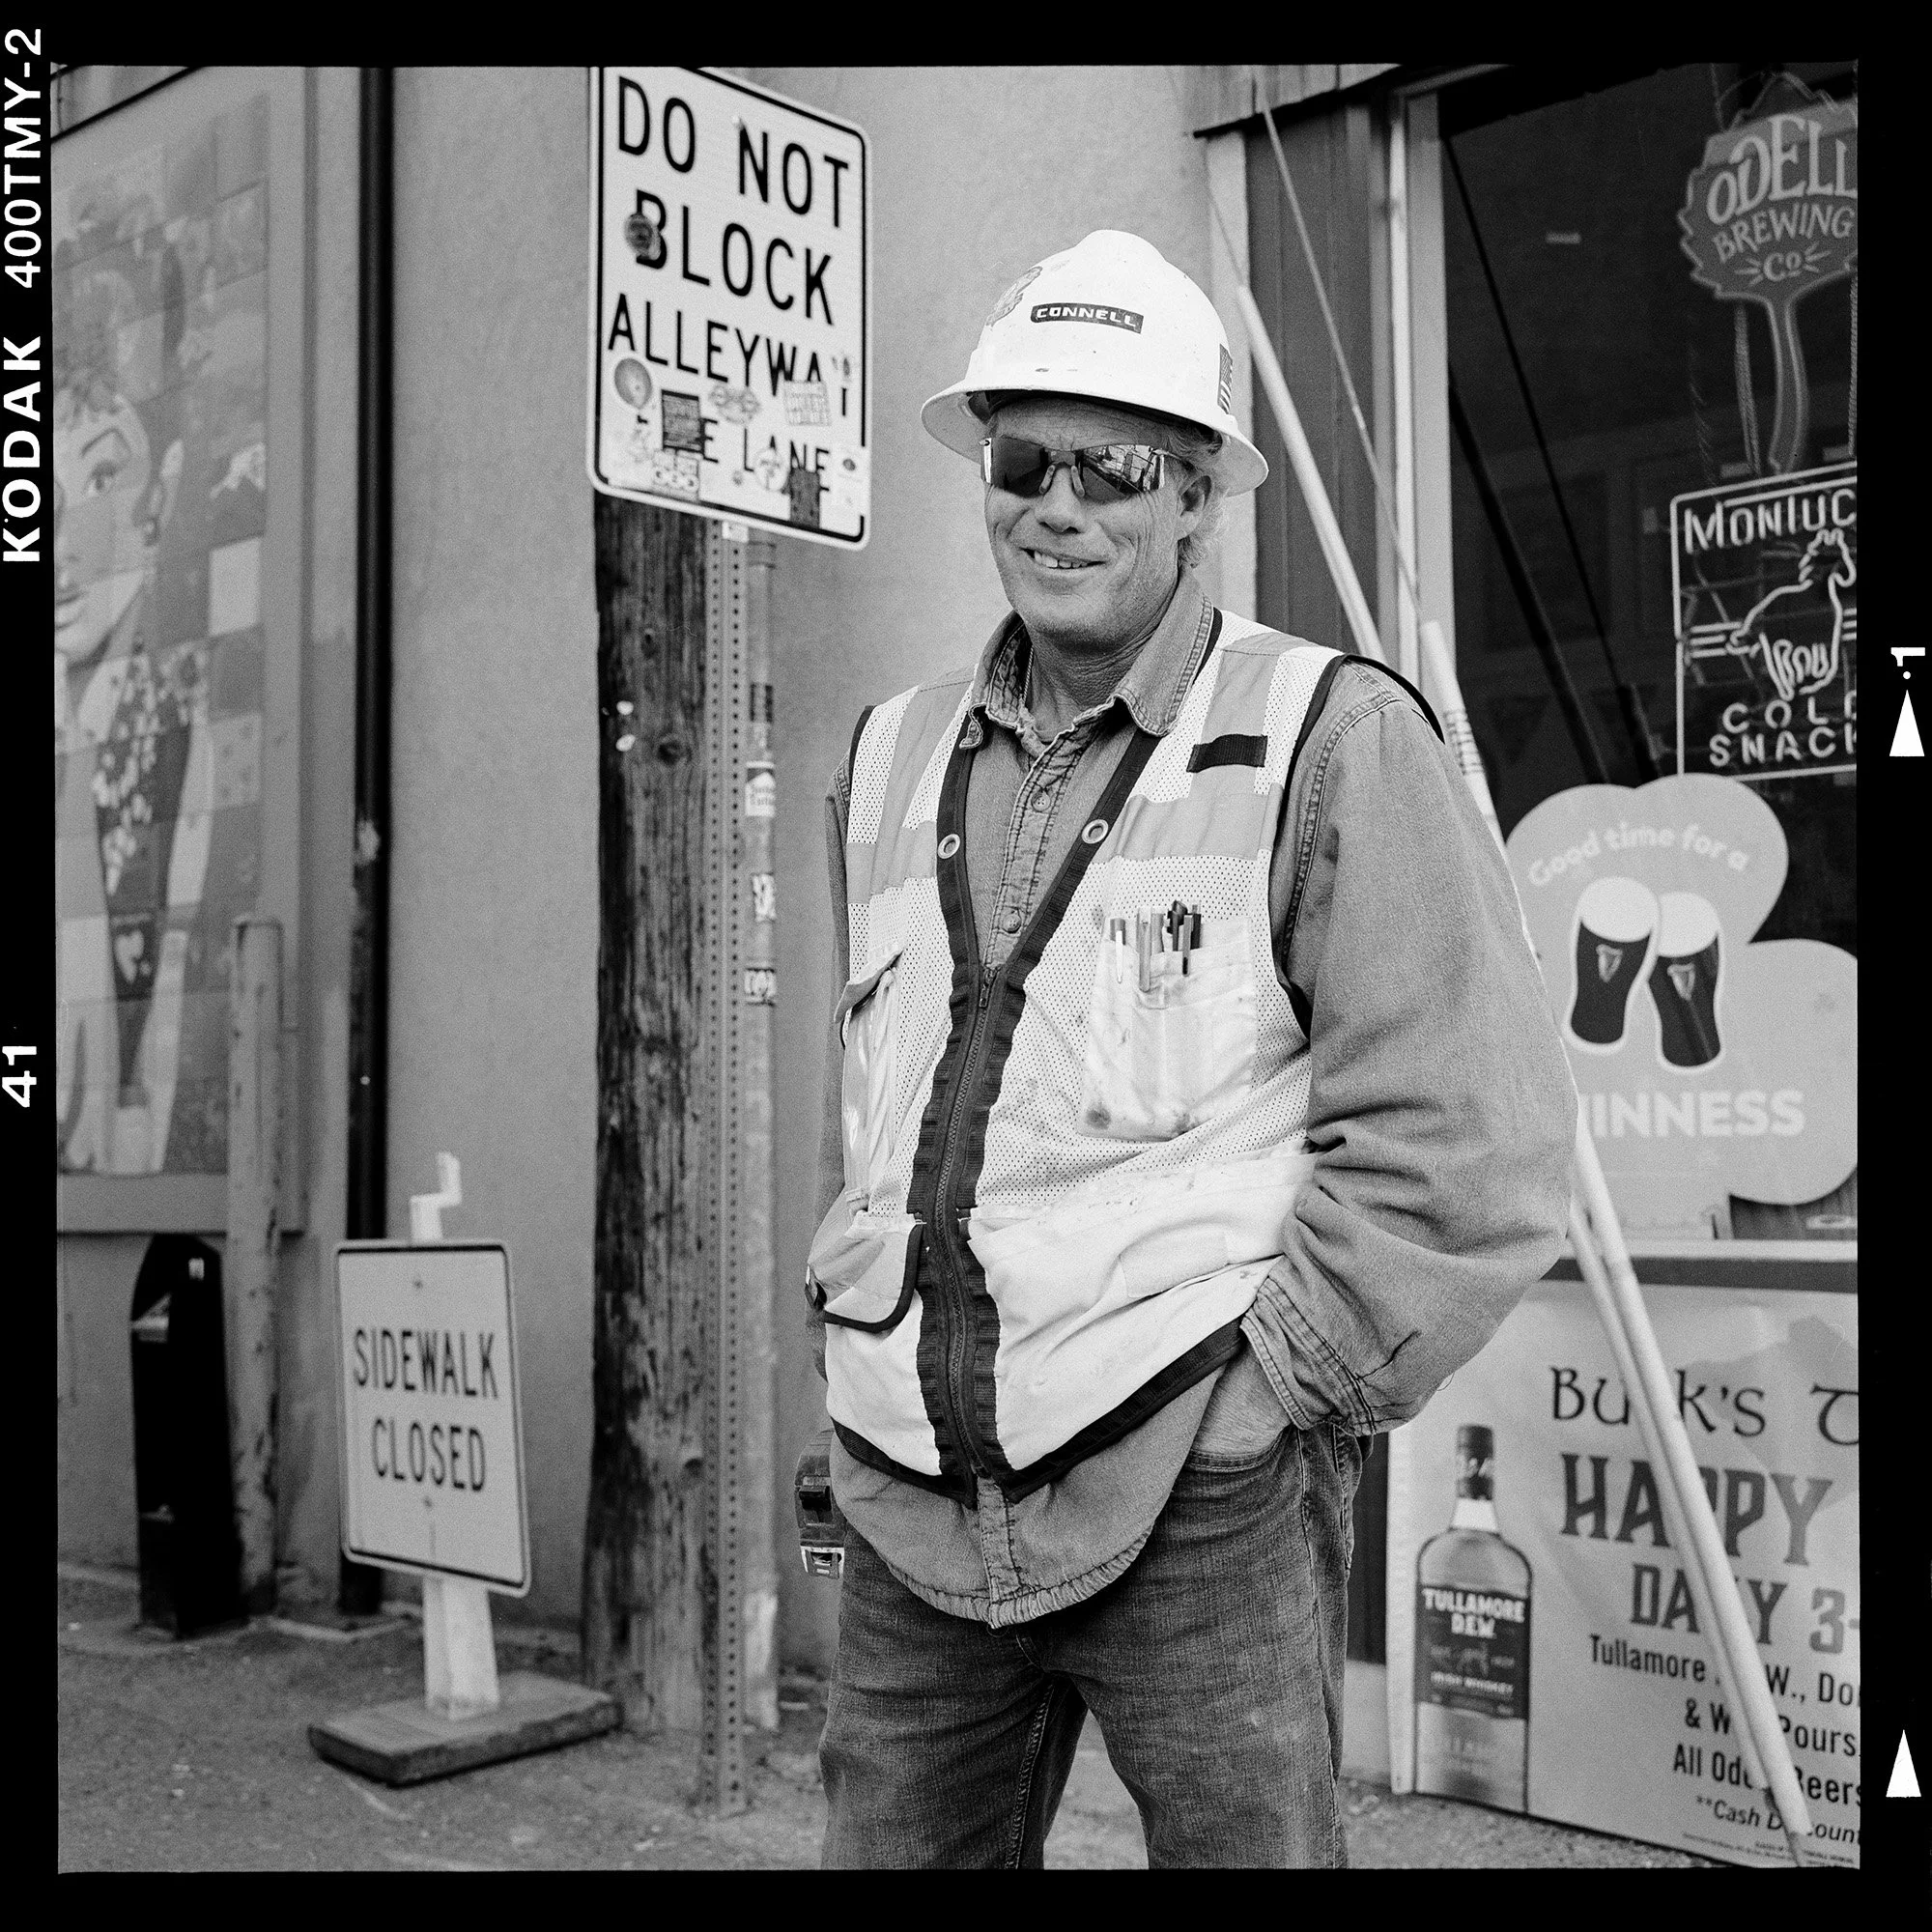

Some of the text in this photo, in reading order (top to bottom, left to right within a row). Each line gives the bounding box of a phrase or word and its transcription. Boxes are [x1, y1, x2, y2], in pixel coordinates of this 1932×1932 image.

[618, 75, 849, 228] DO NOT
[1706, 112, 1858, 226] ODELL
[635, 188, 834, 326] BLOCK
[1713, 201, 1856, 264] BREWING
[2, 27, 42, 563] KODAK 400TMY-2
[1035, 305, 1138, 328] CONNELL
[1528, 820, 1750, 887] Good time for a
[2, 1045, 37, 1108] 41
[1582, 1088, 1805, 1139] INNESS
[353, 1326, 499, 1400] SIDEWALK
[1550, 1365, 1767, 1438] Buk's
[372, 1416, 486, 1492] CLOSED
[1421, 1586, 1526, 1624] TULLAMORE
[1629, 1561, 1789, 1645] DAY
[1590, 1633, 1706, 1684] Tullamore
[1818, 1671, 1861, 1707] Do
[1684, 1696, 1701, 1730] &
[1672, 1743, 1702, 1777] All
